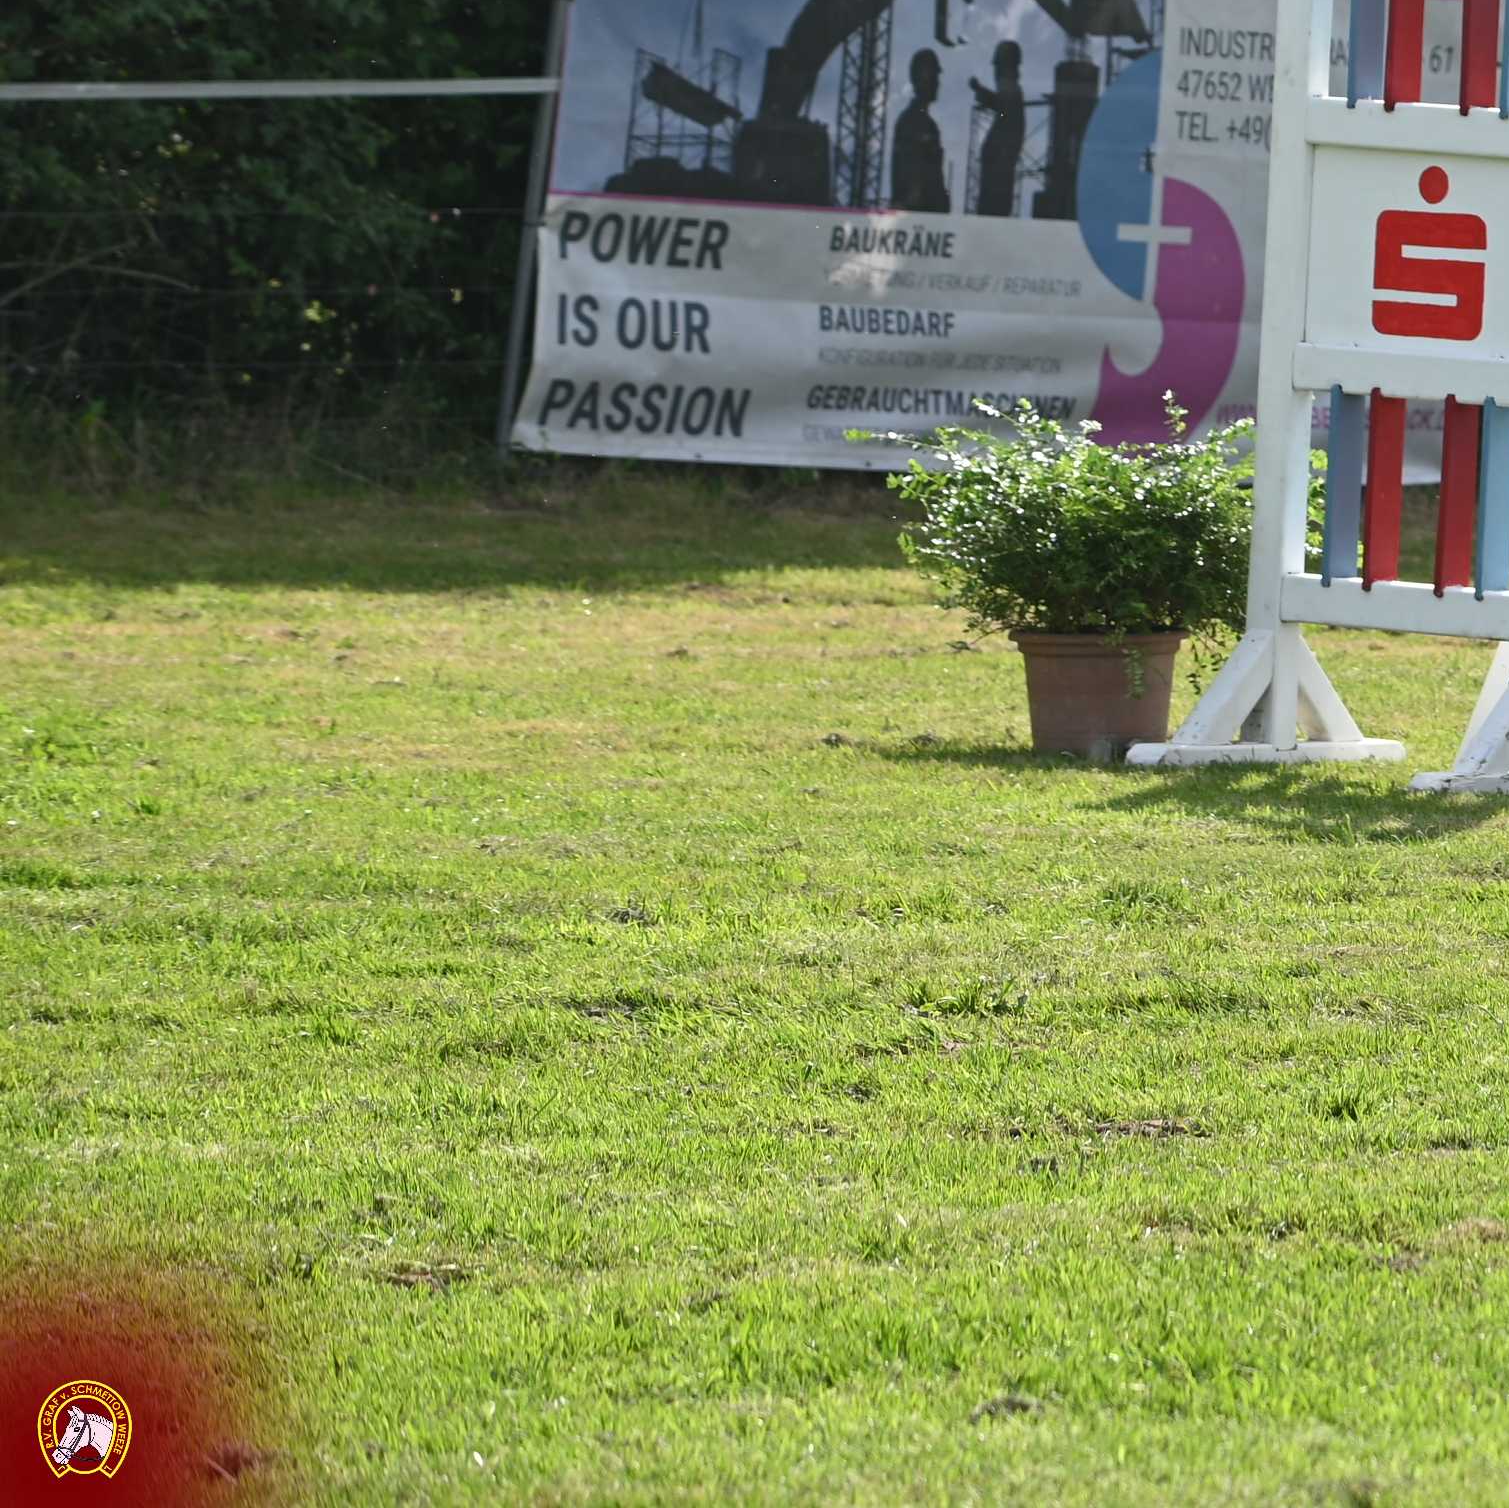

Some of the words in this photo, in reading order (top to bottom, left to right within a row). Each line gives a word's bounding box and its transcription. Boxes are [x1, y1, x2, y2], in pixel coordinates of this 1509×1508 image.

[1177, 69, 1243, 102] 47652
[1248, 74, 1274, 103] W
[559, 210, 730, 271] POWER
[829, 225, 956, 258] BAUKRÄNE
[557, 293, 600, 348] IS
[616, 297, 711, 354] OUR
[818, 305, 956, 338] BAUBEDARF
[538, 378, 753, 439] PASSION
